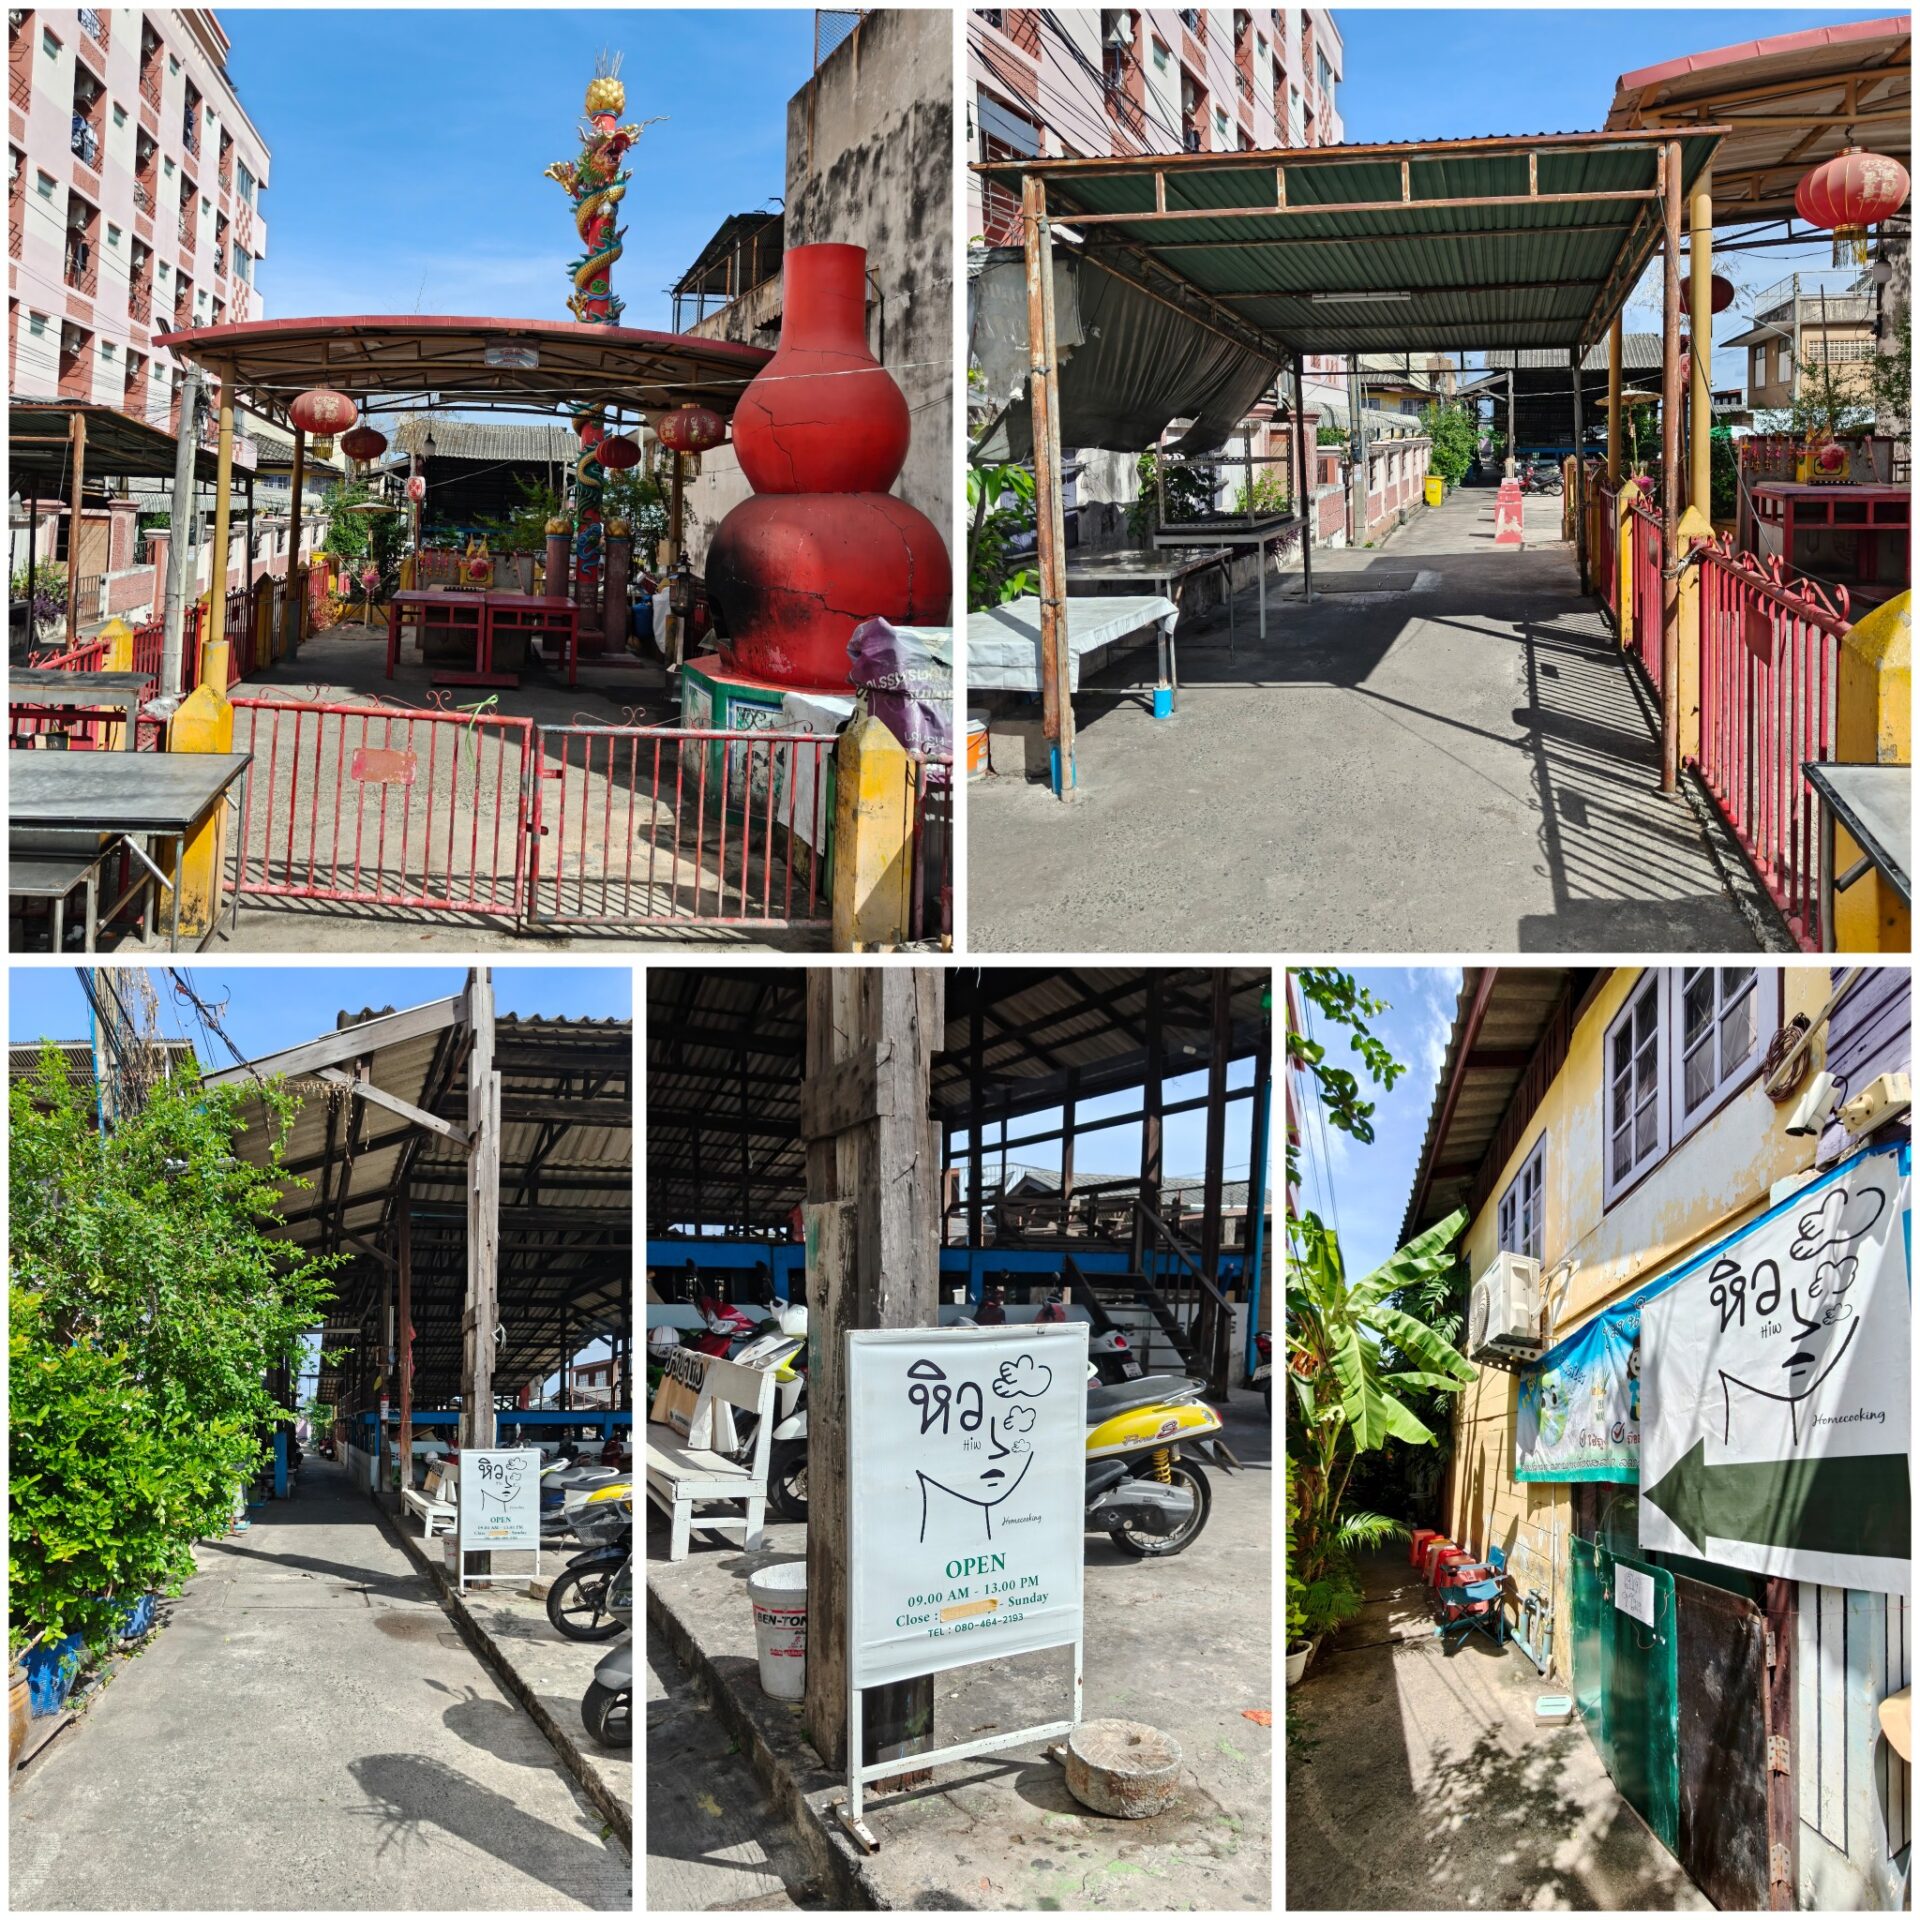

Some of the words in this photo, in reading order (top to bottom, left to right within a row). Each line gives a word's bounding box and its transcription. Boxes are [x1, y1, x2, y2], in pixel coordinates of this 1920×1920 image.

[1708, 1258, 1780, 1333] หิว
[907, 1358, 983, 1435] หิว
[1812, 1407, 1886, 1427] Homecooking
[478, 1457, 504, 1480] หิว
[490, 1516, 512, 1524] OPEN
[1002, 1512, 1042, 1526] Homecooking
[945, 1552, 1006, 1579] OPEN
[907, 1592, 943, 1608] 09.00
[947, 1586, 969, 1601] AM
[984, 1580, 1016, 1595] 13.00
[1020, 1575, 1039, 1589] PM
[896, 1614, 930, 1628] Close
[1008, 1592, 1049, 1607] Sunday
[928, 1629, 944, 1638] TEL
[954, 1612, 1024, 1633] 080-464-2193
